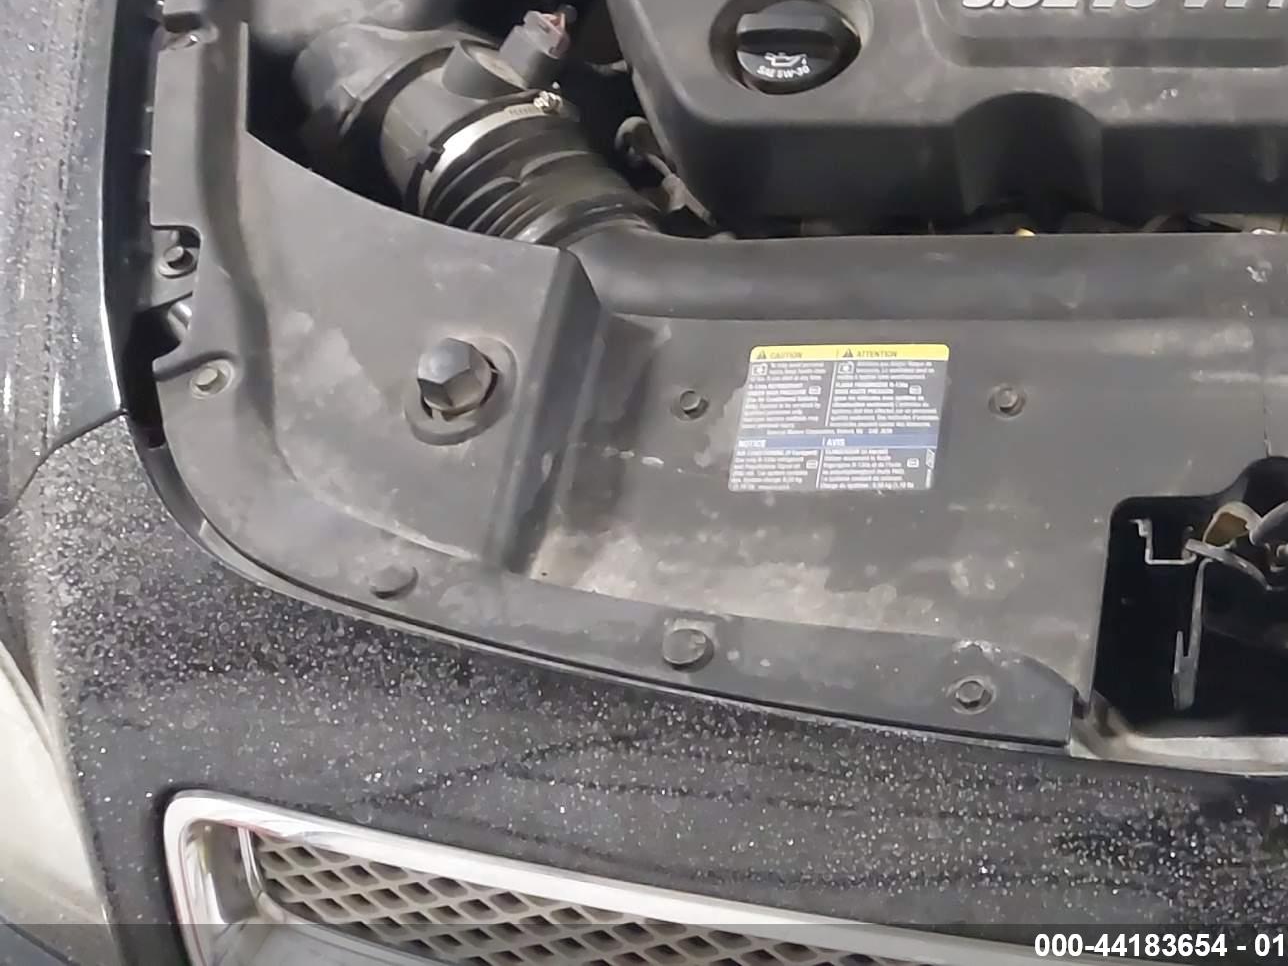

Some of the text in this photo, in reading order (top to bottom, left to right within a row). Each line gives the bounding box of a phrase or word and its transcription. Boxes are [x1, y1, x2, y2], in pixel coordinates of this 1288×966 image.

[769, 351, 803, 359] CAUTION
[856, 350, 898, 358] ATTENTION
[738, 439, 767, 447] NOTICE
[826, 438, 846, 447] AVIS
